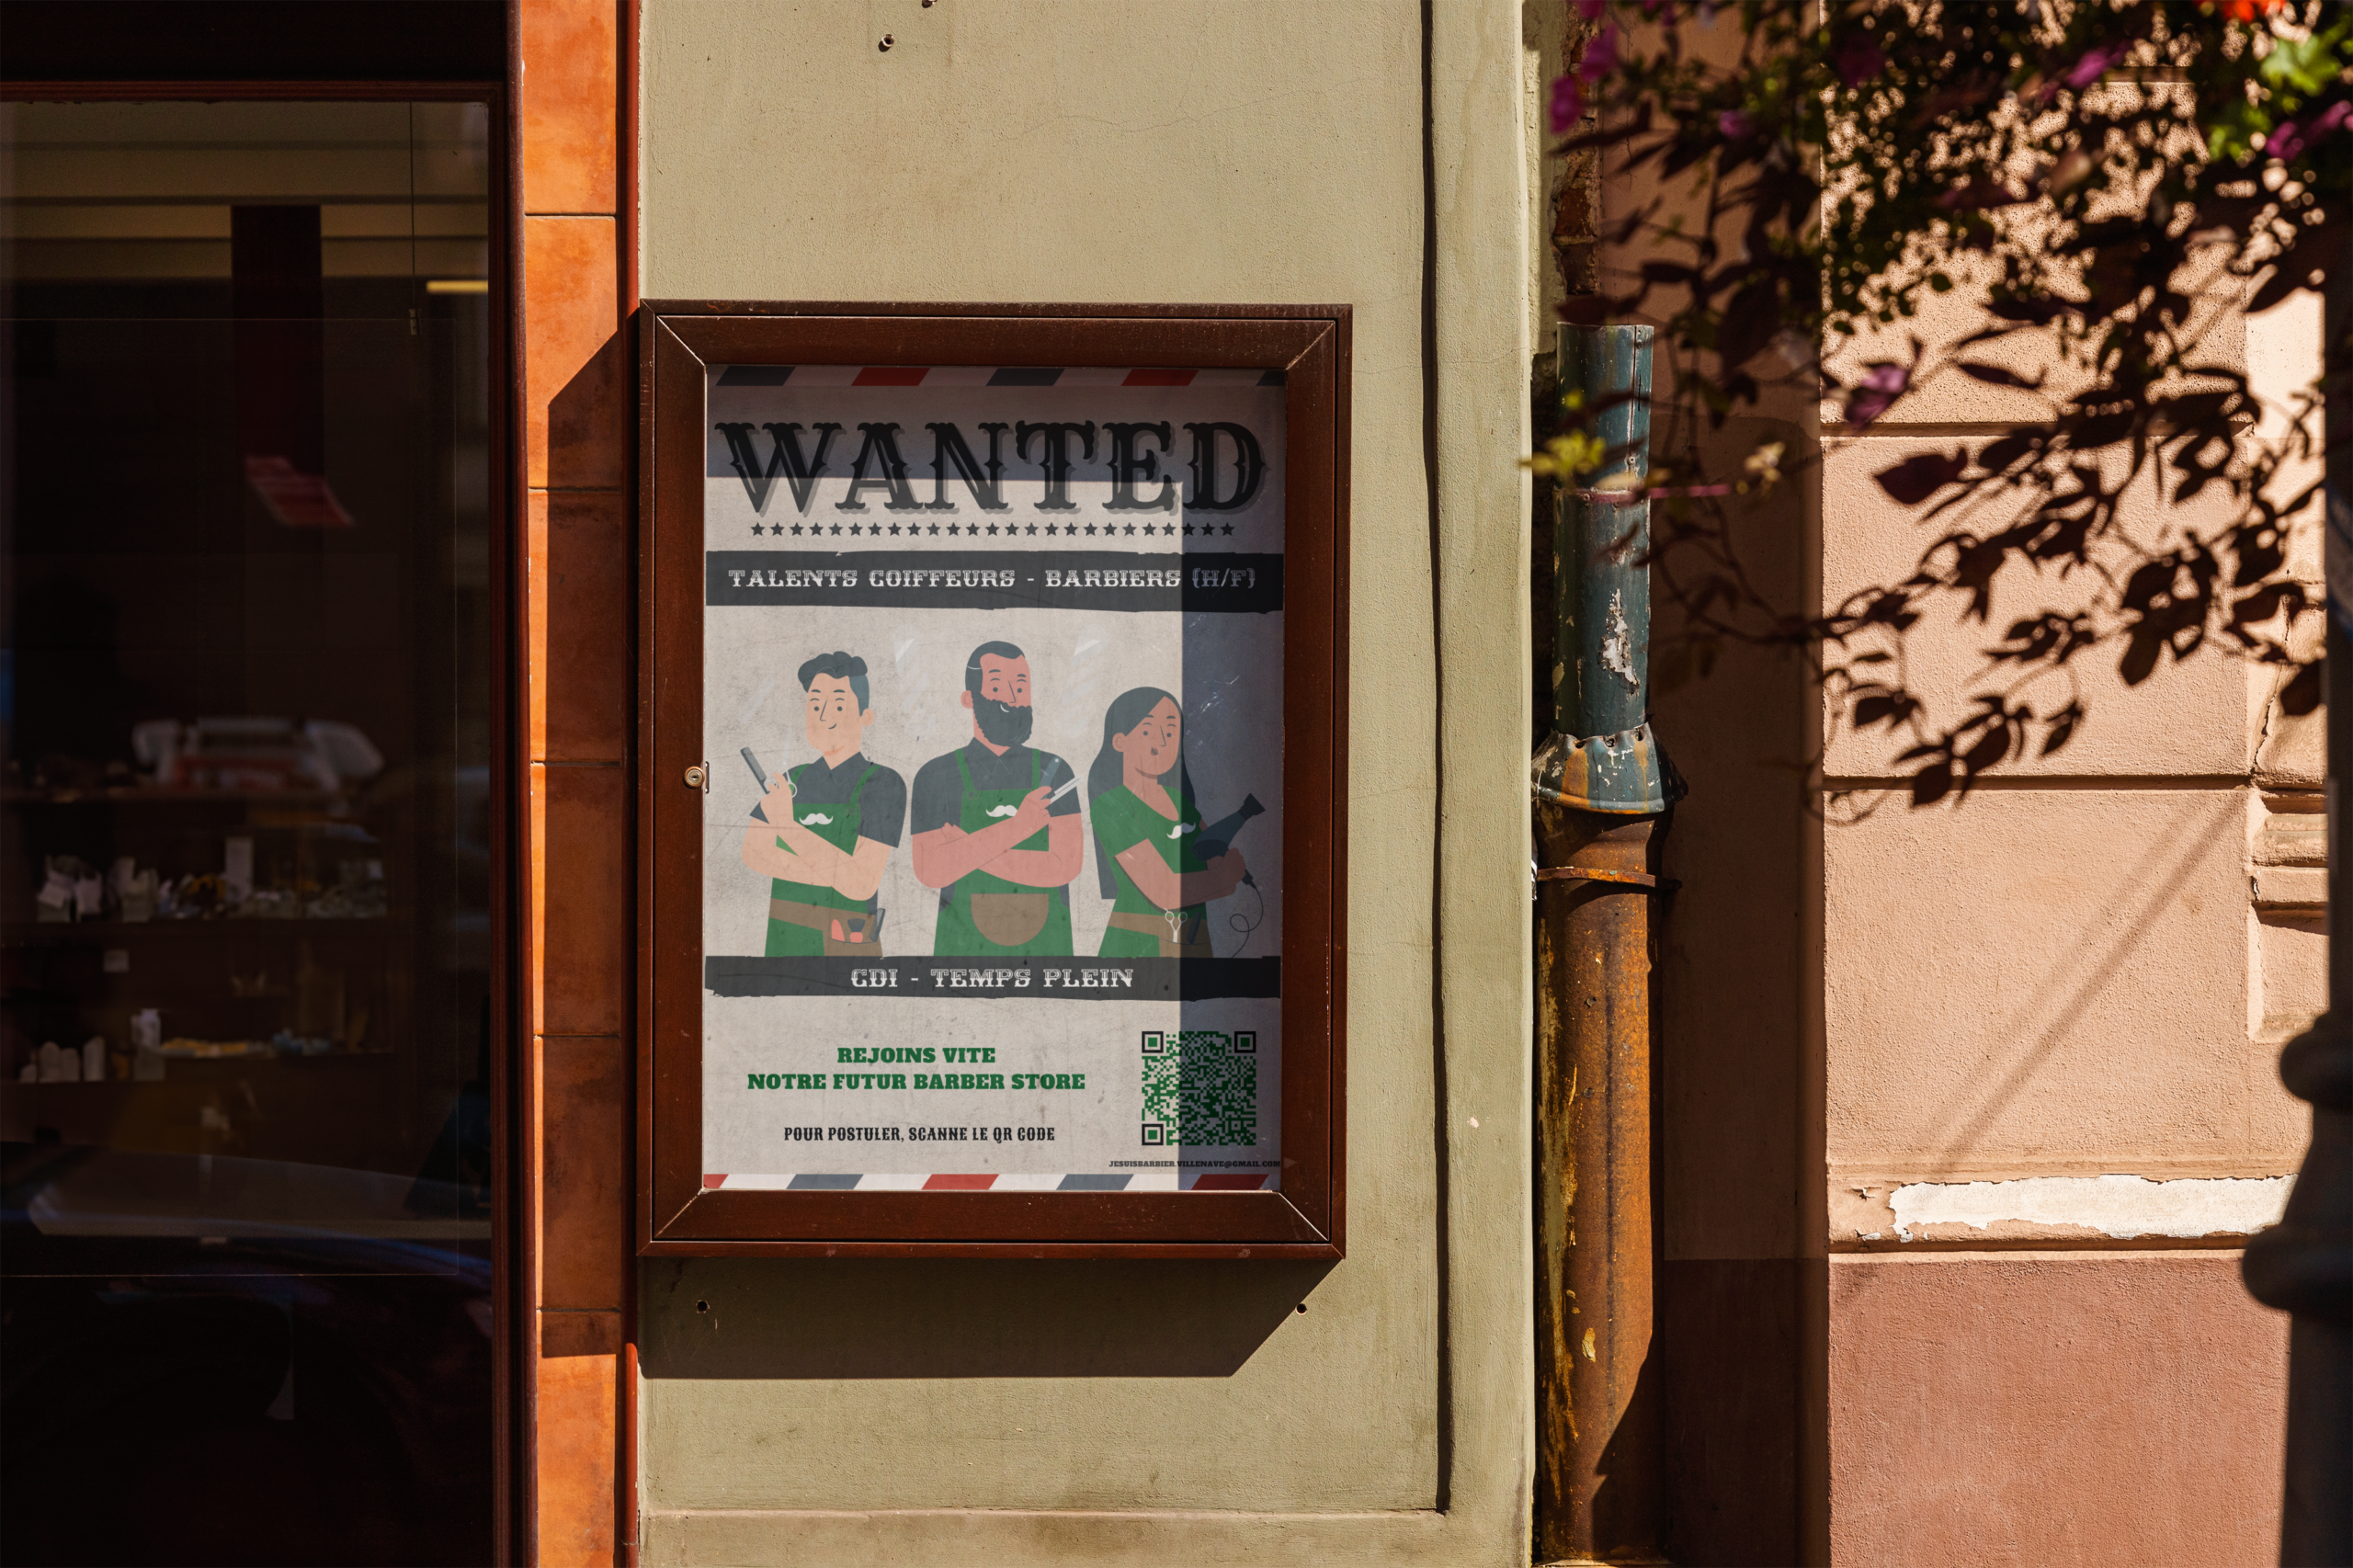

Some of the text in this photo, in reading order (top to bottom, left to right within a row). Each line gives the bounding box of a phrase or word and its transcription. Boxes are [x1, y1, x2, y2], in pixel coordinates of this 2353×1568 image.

[714, 420, 1268, 516] WANTED
[728, 570, 858, 587] TALENTS
[869, 570, 1016, 587] COIFFEURS
[1045, 570, 1182, 587] BARBIERS
[1192, 568, 1256, 589] (H/F)
[851, 969, 898, 988] CDI
[930, 969, 1031, 988] TEMPS
[1043, 969, 1134, 988] PLEIN
[837, 1047, 995, 1063] REJOINS VITE
[747, 1074, 1086, 1090] NOTRE FUTUR BARBER STORE
[784, 1127, 1055, 1143] POUR POSTULER, SCANNE LE QR CODE
[1108, 1160, 1281, 1169] JESUISBARBIER.VILLENAVE@GMAIL.COM
